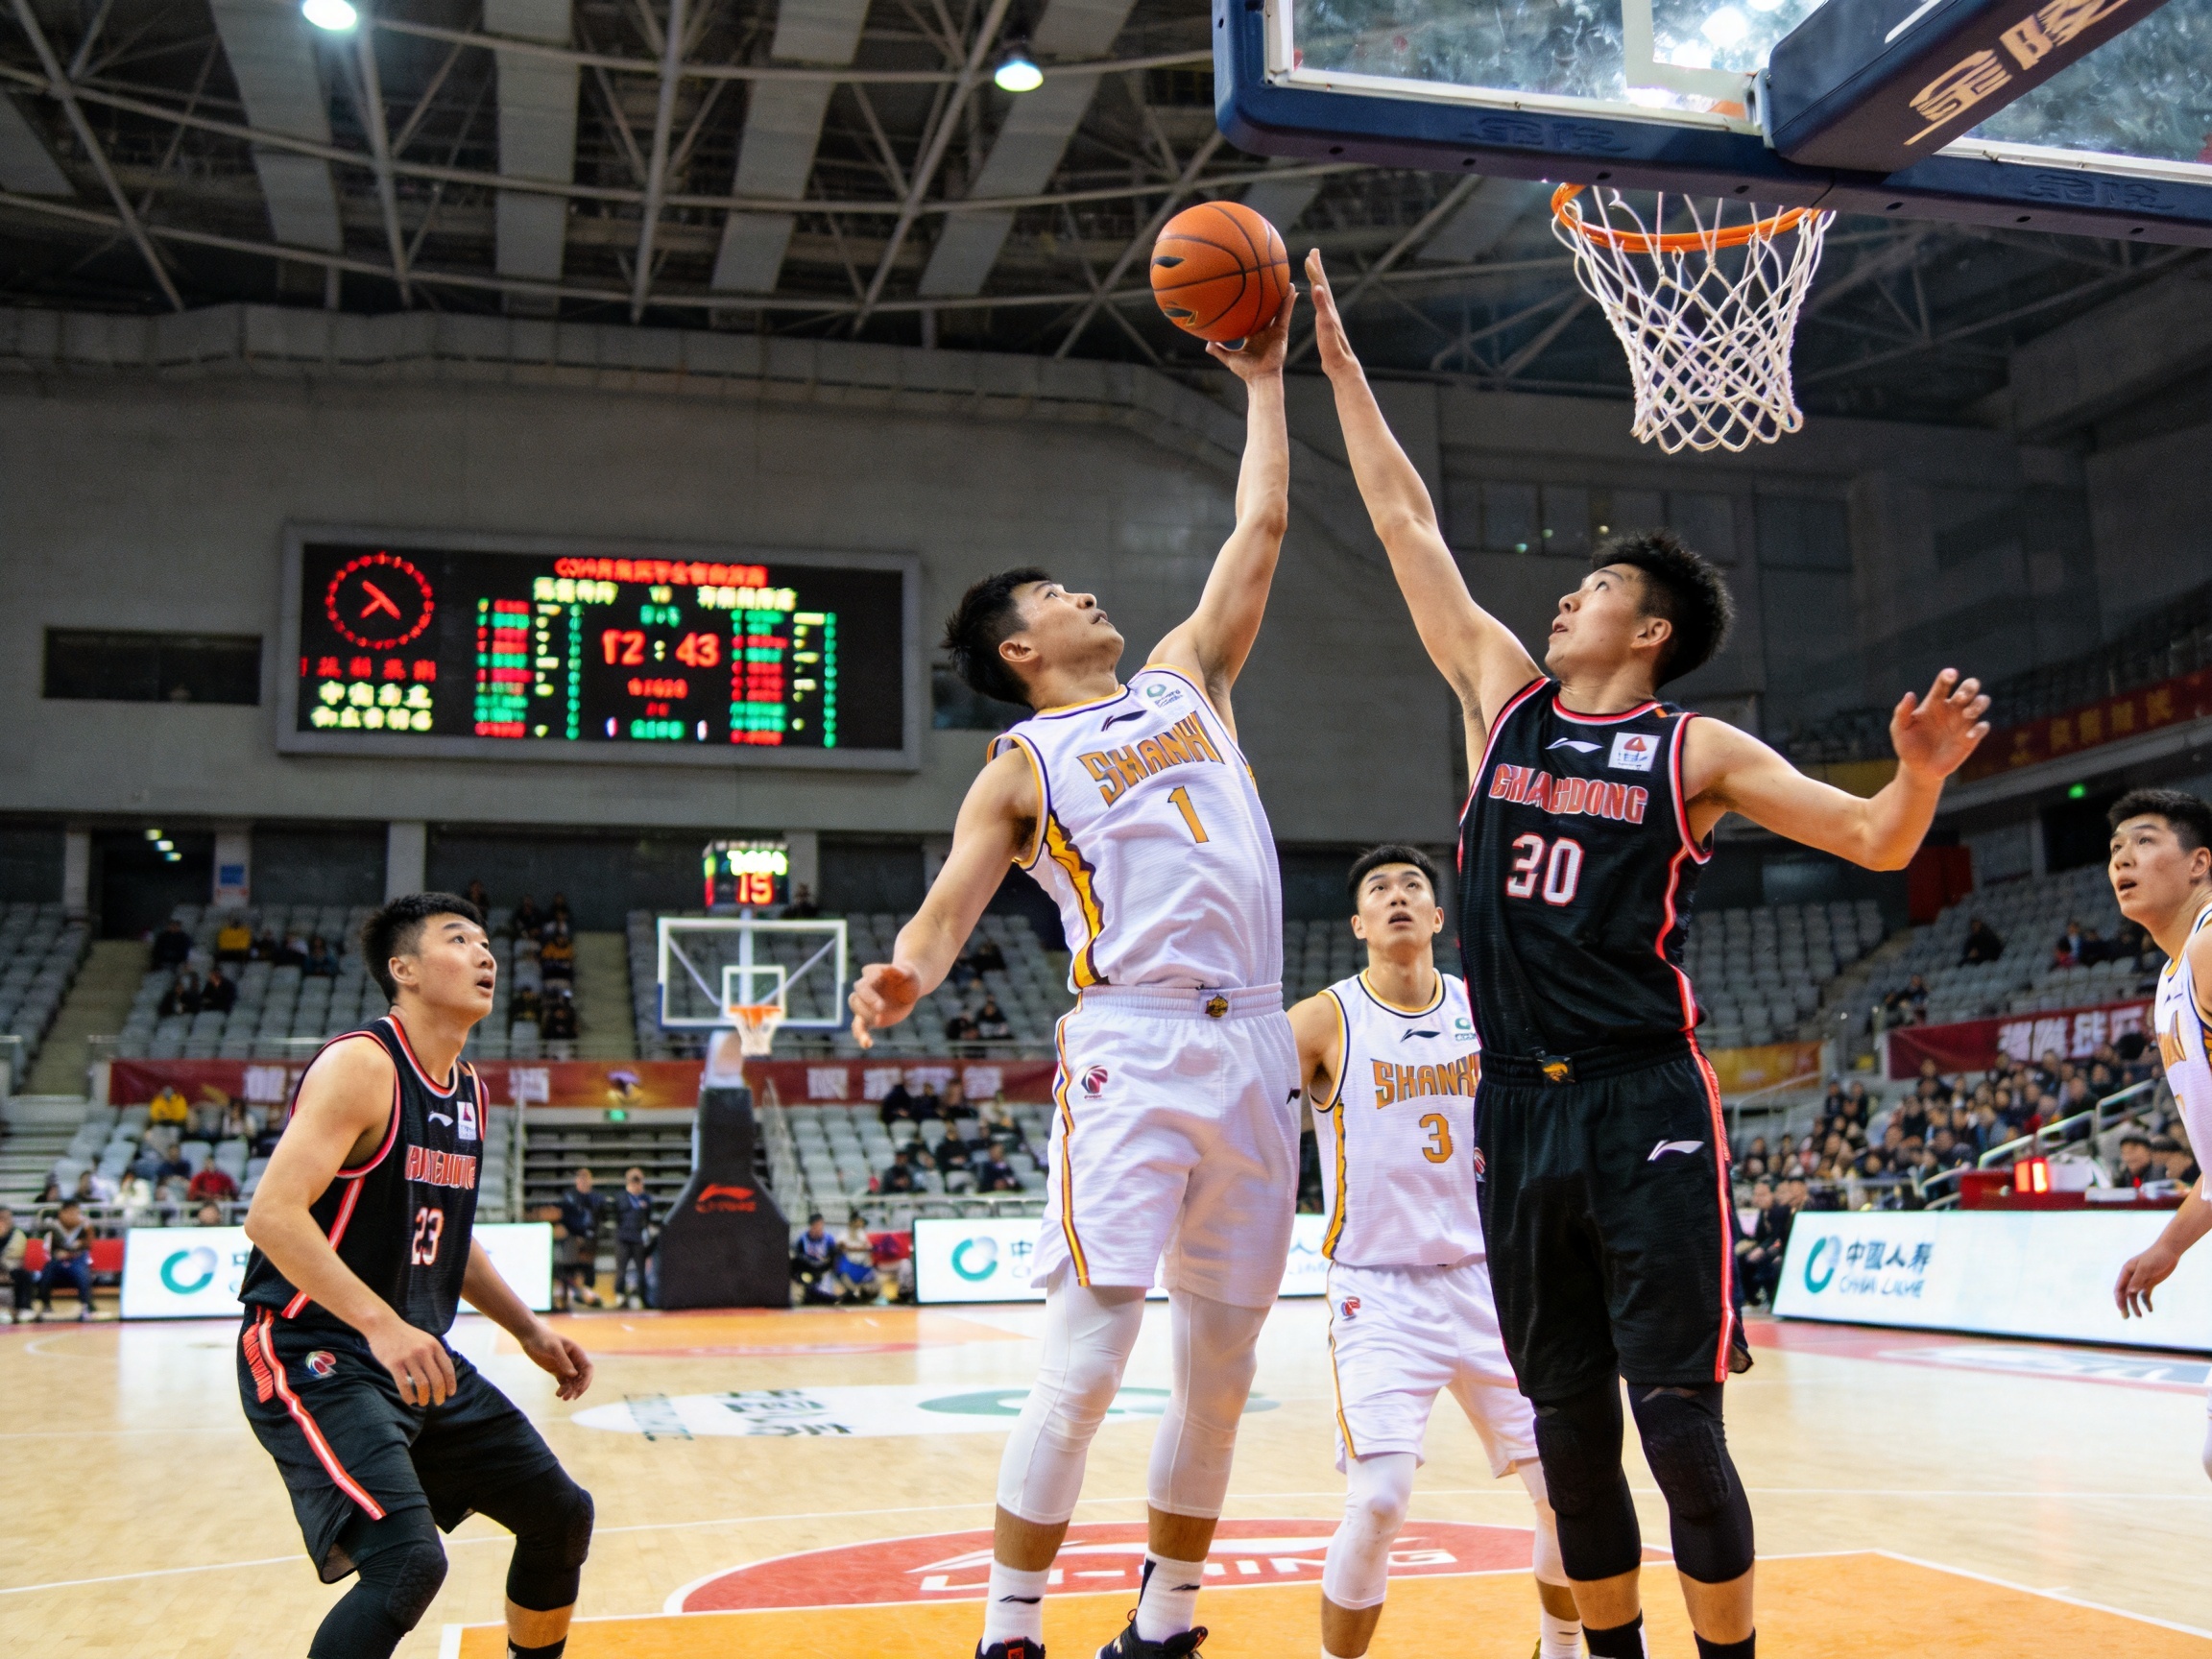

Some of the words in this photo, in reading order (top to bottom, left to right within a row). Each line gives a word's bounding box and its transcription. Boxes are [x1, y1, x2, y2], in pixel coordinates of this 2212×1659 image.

[675, 632, 719, 667] 43
[1167, 785, 1210, 844] 1
[1505, 831, 1585, 907] 30
[1419, 1113, 1454, 1164] 3
[410, 1207, 445, 1266] 23
